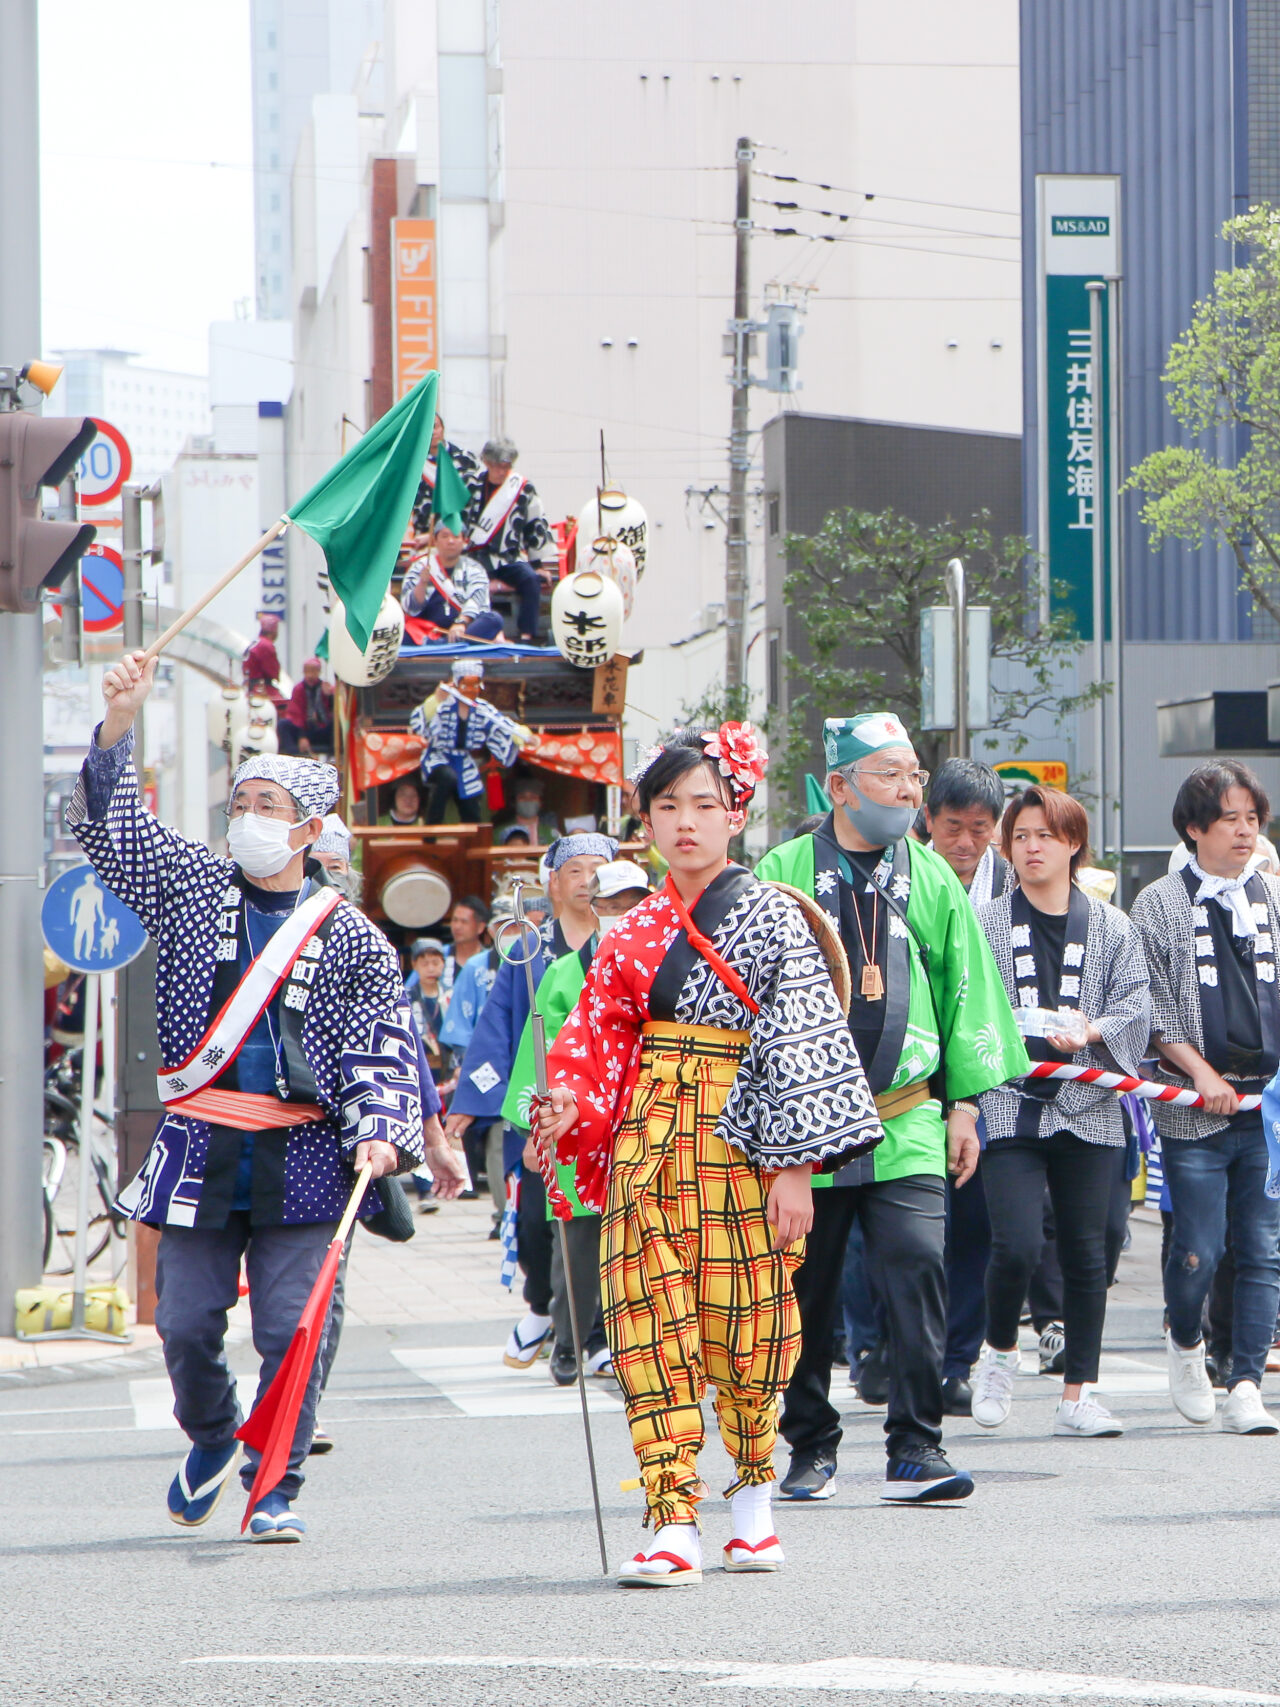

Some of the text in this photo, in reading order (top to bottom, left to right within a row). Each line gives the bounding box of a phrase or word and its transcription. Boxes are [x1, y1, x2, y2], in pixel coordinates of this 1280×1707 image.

[1055, 220, 1107, 234] MS&AD
[1066, 329, 1095, 530] 三井住友海上
